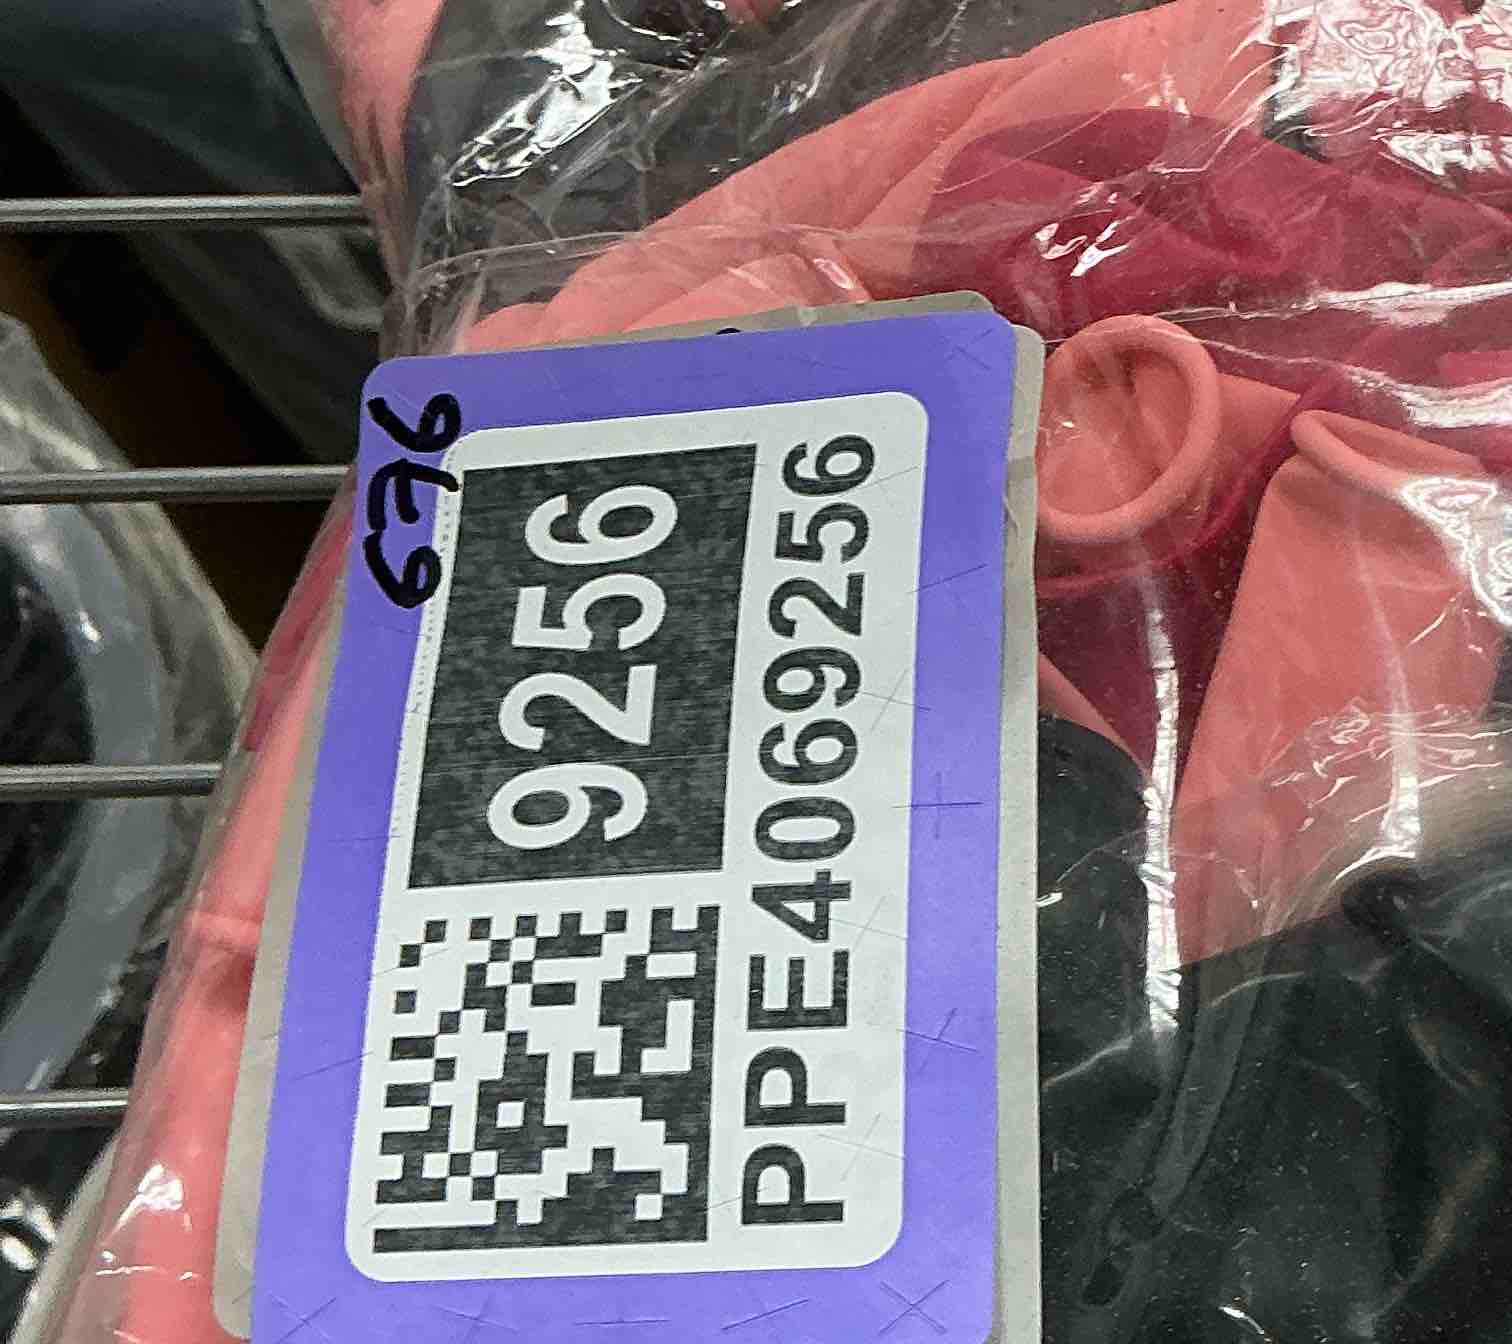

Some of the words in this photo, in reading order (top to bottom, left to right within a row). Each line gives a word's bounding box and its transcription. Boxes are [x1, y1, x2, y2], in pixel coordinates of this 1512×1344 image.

[363, 393, 461, 608] 676
[487, 483, 678, 851] 9256
[740, 433, 875, 1226] PPE4069256
